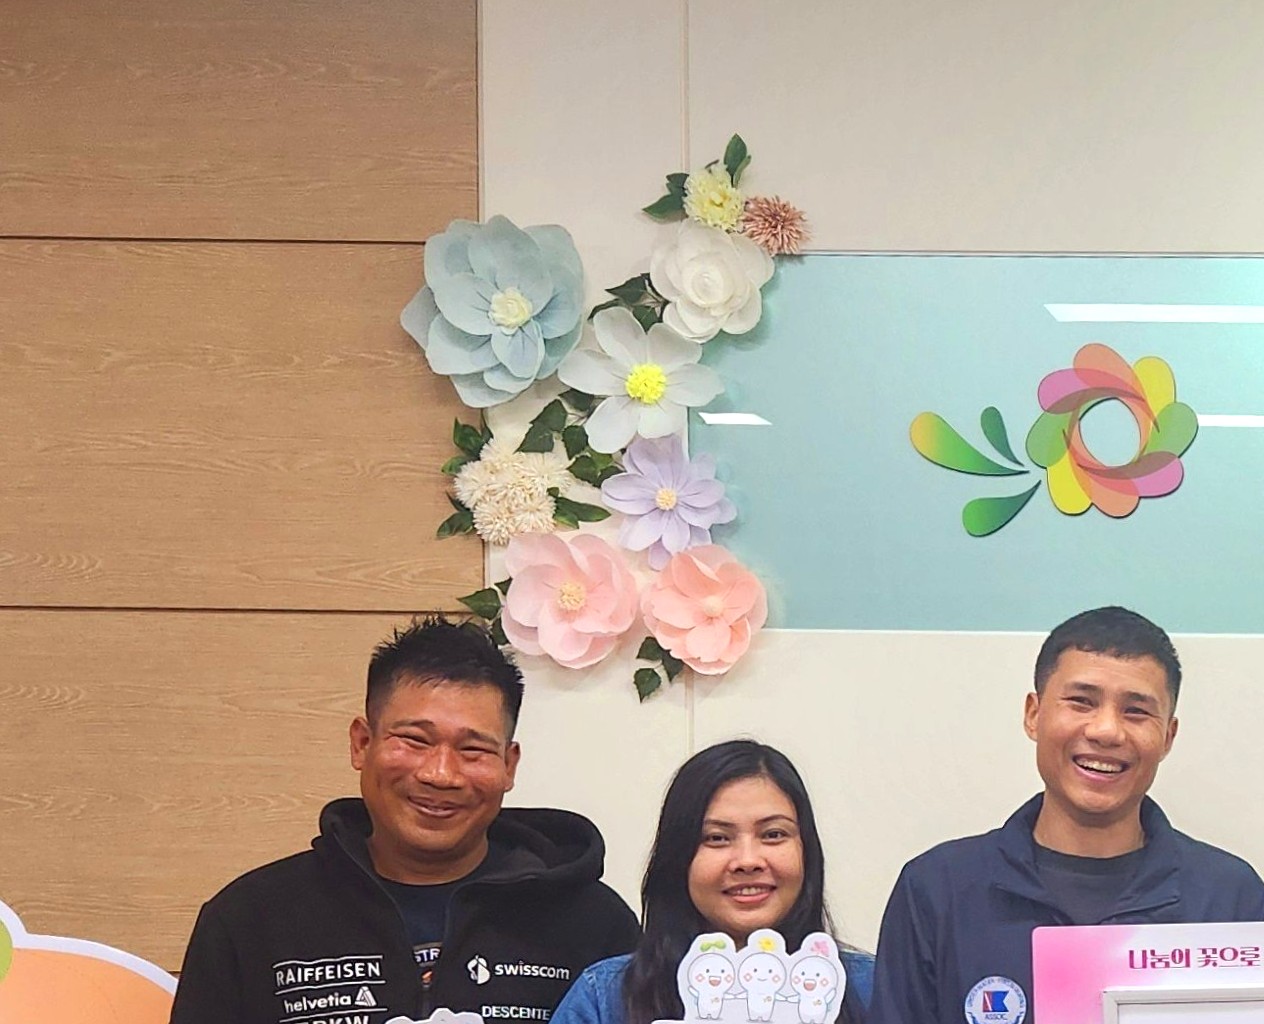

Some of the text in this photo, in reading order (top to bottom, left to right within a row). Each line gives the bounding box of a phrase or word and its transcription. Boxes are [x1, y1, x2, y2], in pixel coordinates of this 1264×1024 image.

[1128, 948, 1191, 969] 나눔의
[1197, 946, 1261, 967] 꽃으로
[276, 962, 380, 987] RAIFFEISEN
[494, 960, 570, 980] swisscom
[284, 992, 352, 1014] helvetia
[482, 1005, 551, 1020] DESCENTE
